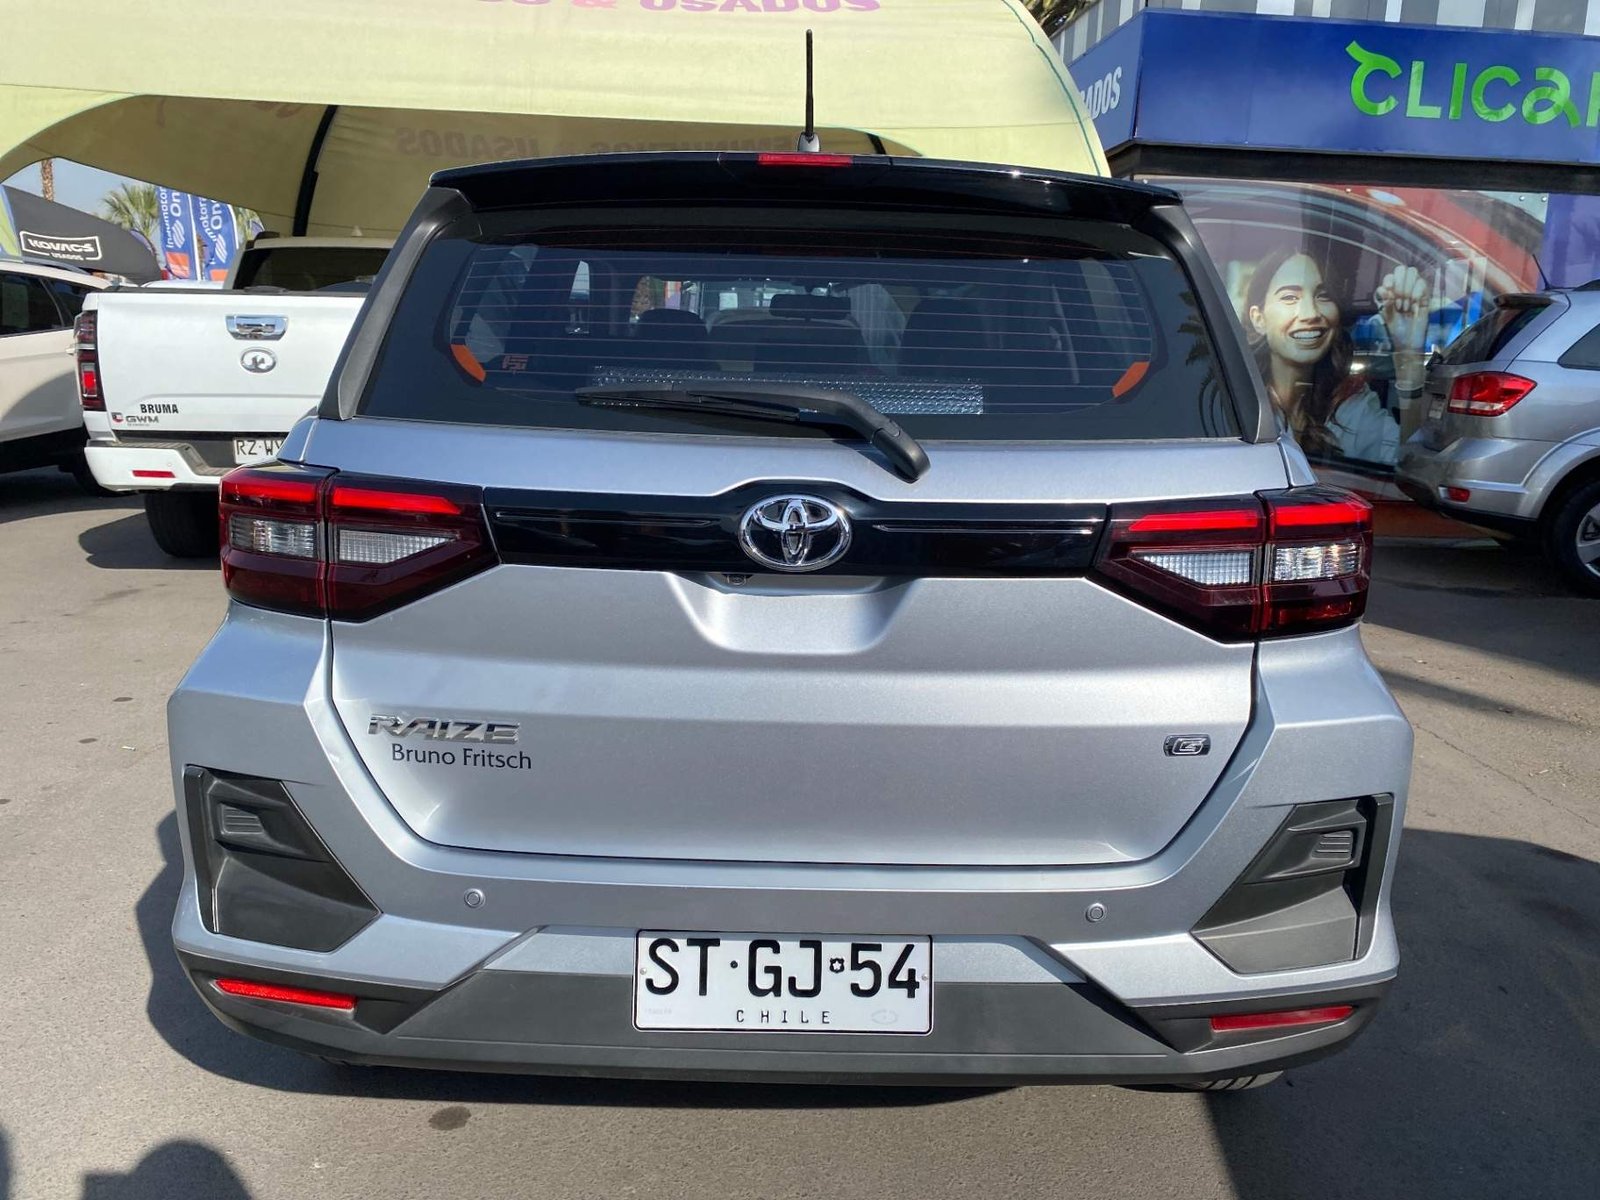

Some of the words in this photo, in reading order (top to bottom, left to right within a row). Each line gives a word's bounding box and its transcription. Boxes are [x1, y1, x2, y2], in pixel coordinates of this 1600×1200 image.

[1080, 66, 1122, 120] ADOS
[210, 199, 222, 230] On
[27, 238, 95, 252] KOVACS
[126, 415, 159, 423] GWM
[140, 404, 178, 414] BRUMA
[368, 714, 520, 745] RAIZE
[392, 743, 456, 765] Bruno
[463, 748, 532, 769] Fritsch
[736, 1010, 832, 1024] CHILE
